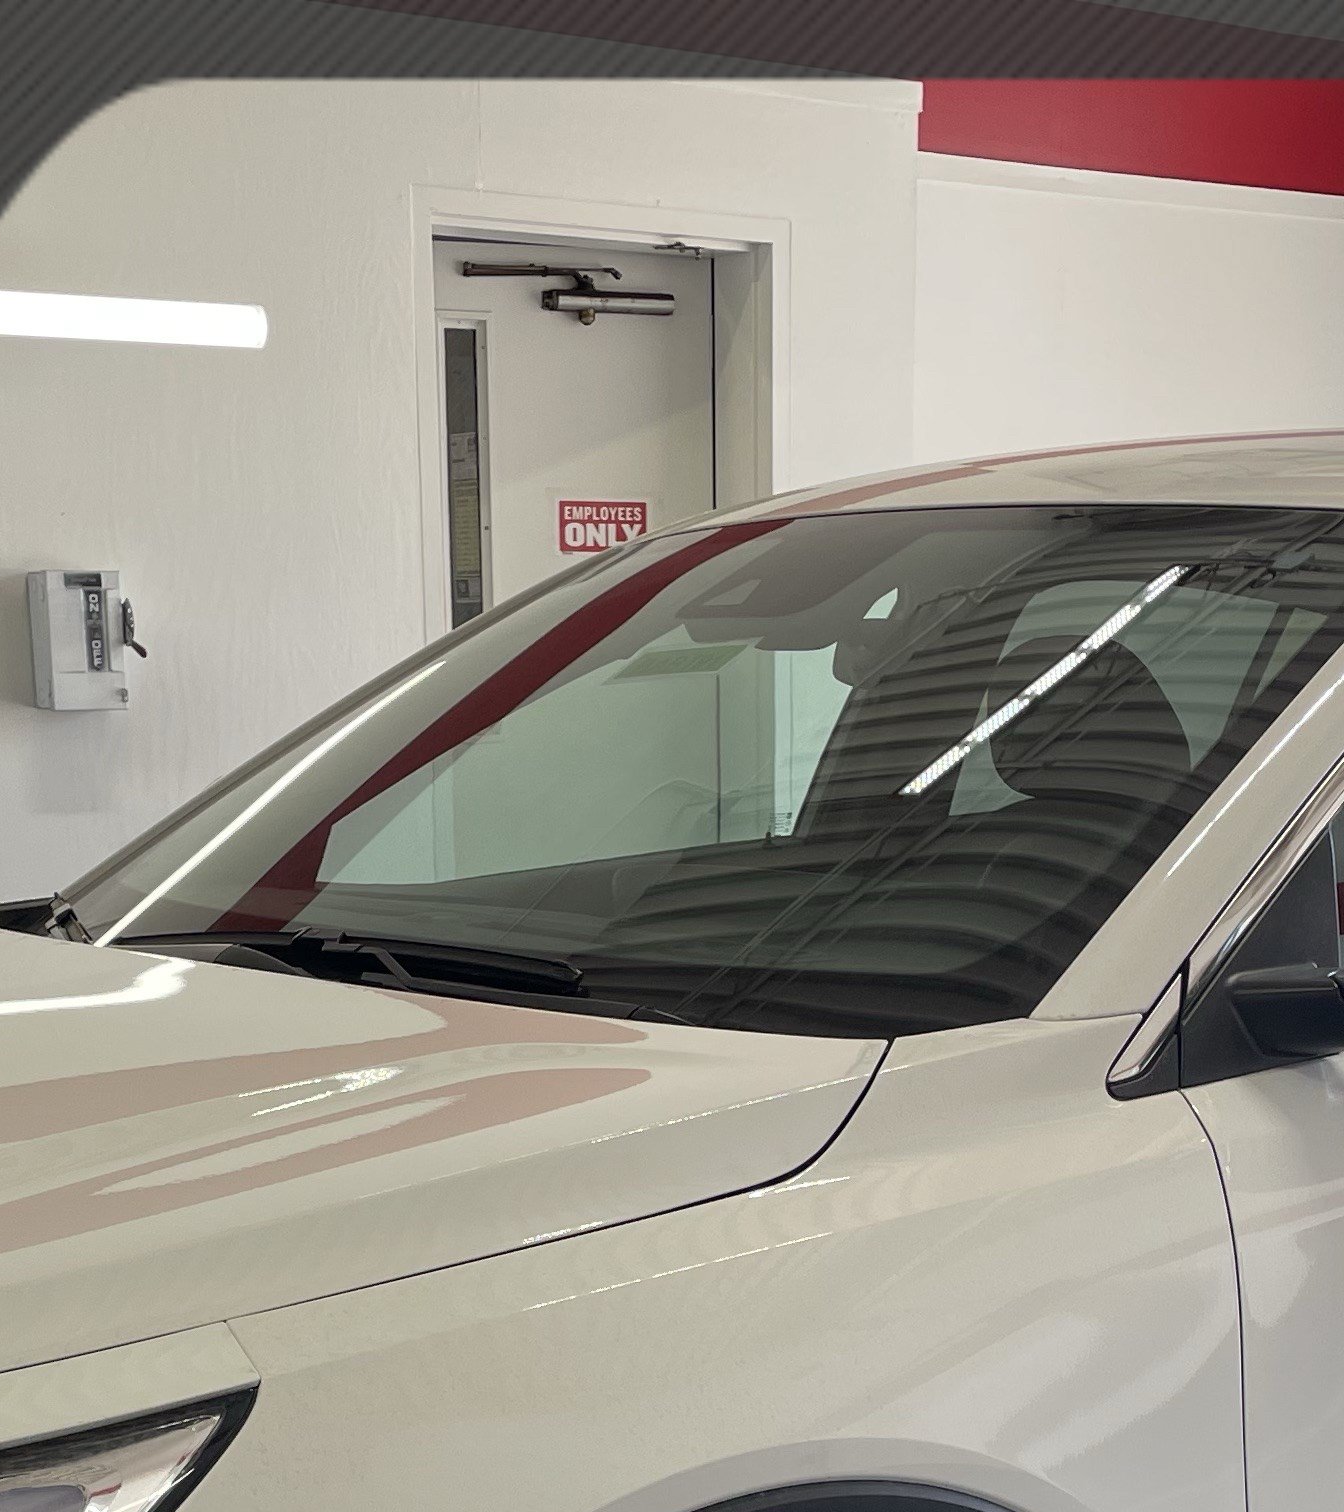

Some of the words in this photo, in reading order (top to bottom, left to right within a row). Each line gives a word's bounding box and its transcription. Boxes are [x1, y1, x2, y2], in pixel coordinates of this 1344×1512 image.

[563, 505, 643, 521] EMPLOYEES
[564, 522, 643, 548] ONLY
[88, 593, 100, 613] ON
